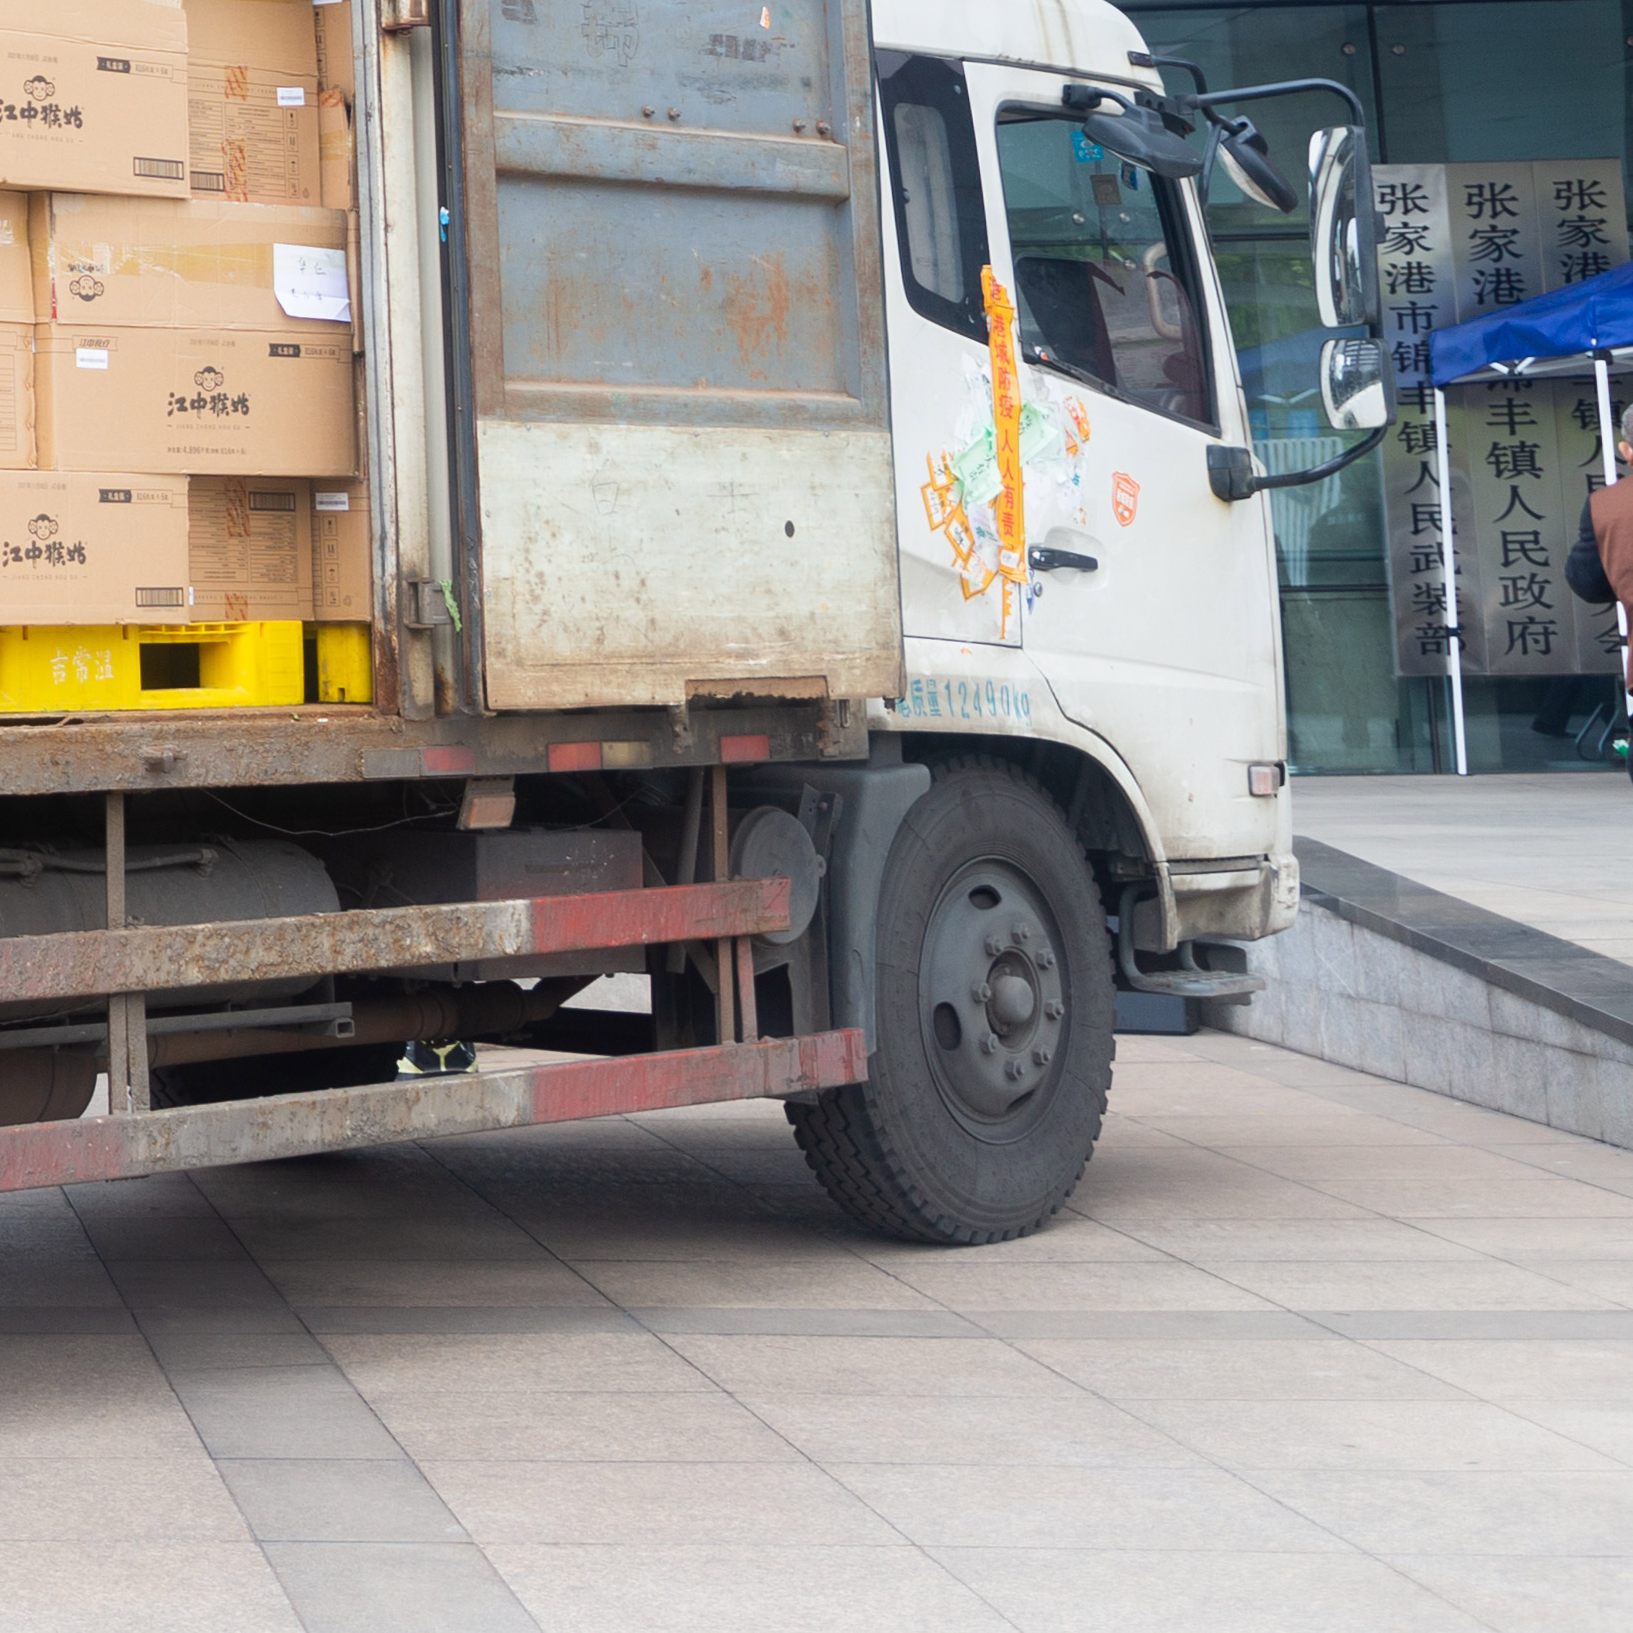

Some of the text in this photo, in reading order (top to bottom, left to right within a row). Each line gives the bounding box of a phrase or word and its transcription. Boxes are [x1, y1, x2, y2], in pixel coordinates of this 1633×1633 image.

[166, 390, 251, 419] 江中猴姑
[1462, 181, 1560, 657] 张家港丰镇人民政府
[1000, 428, 1016, 538] 人人有责
[1, 539, 87, 570] 江中猴姑
